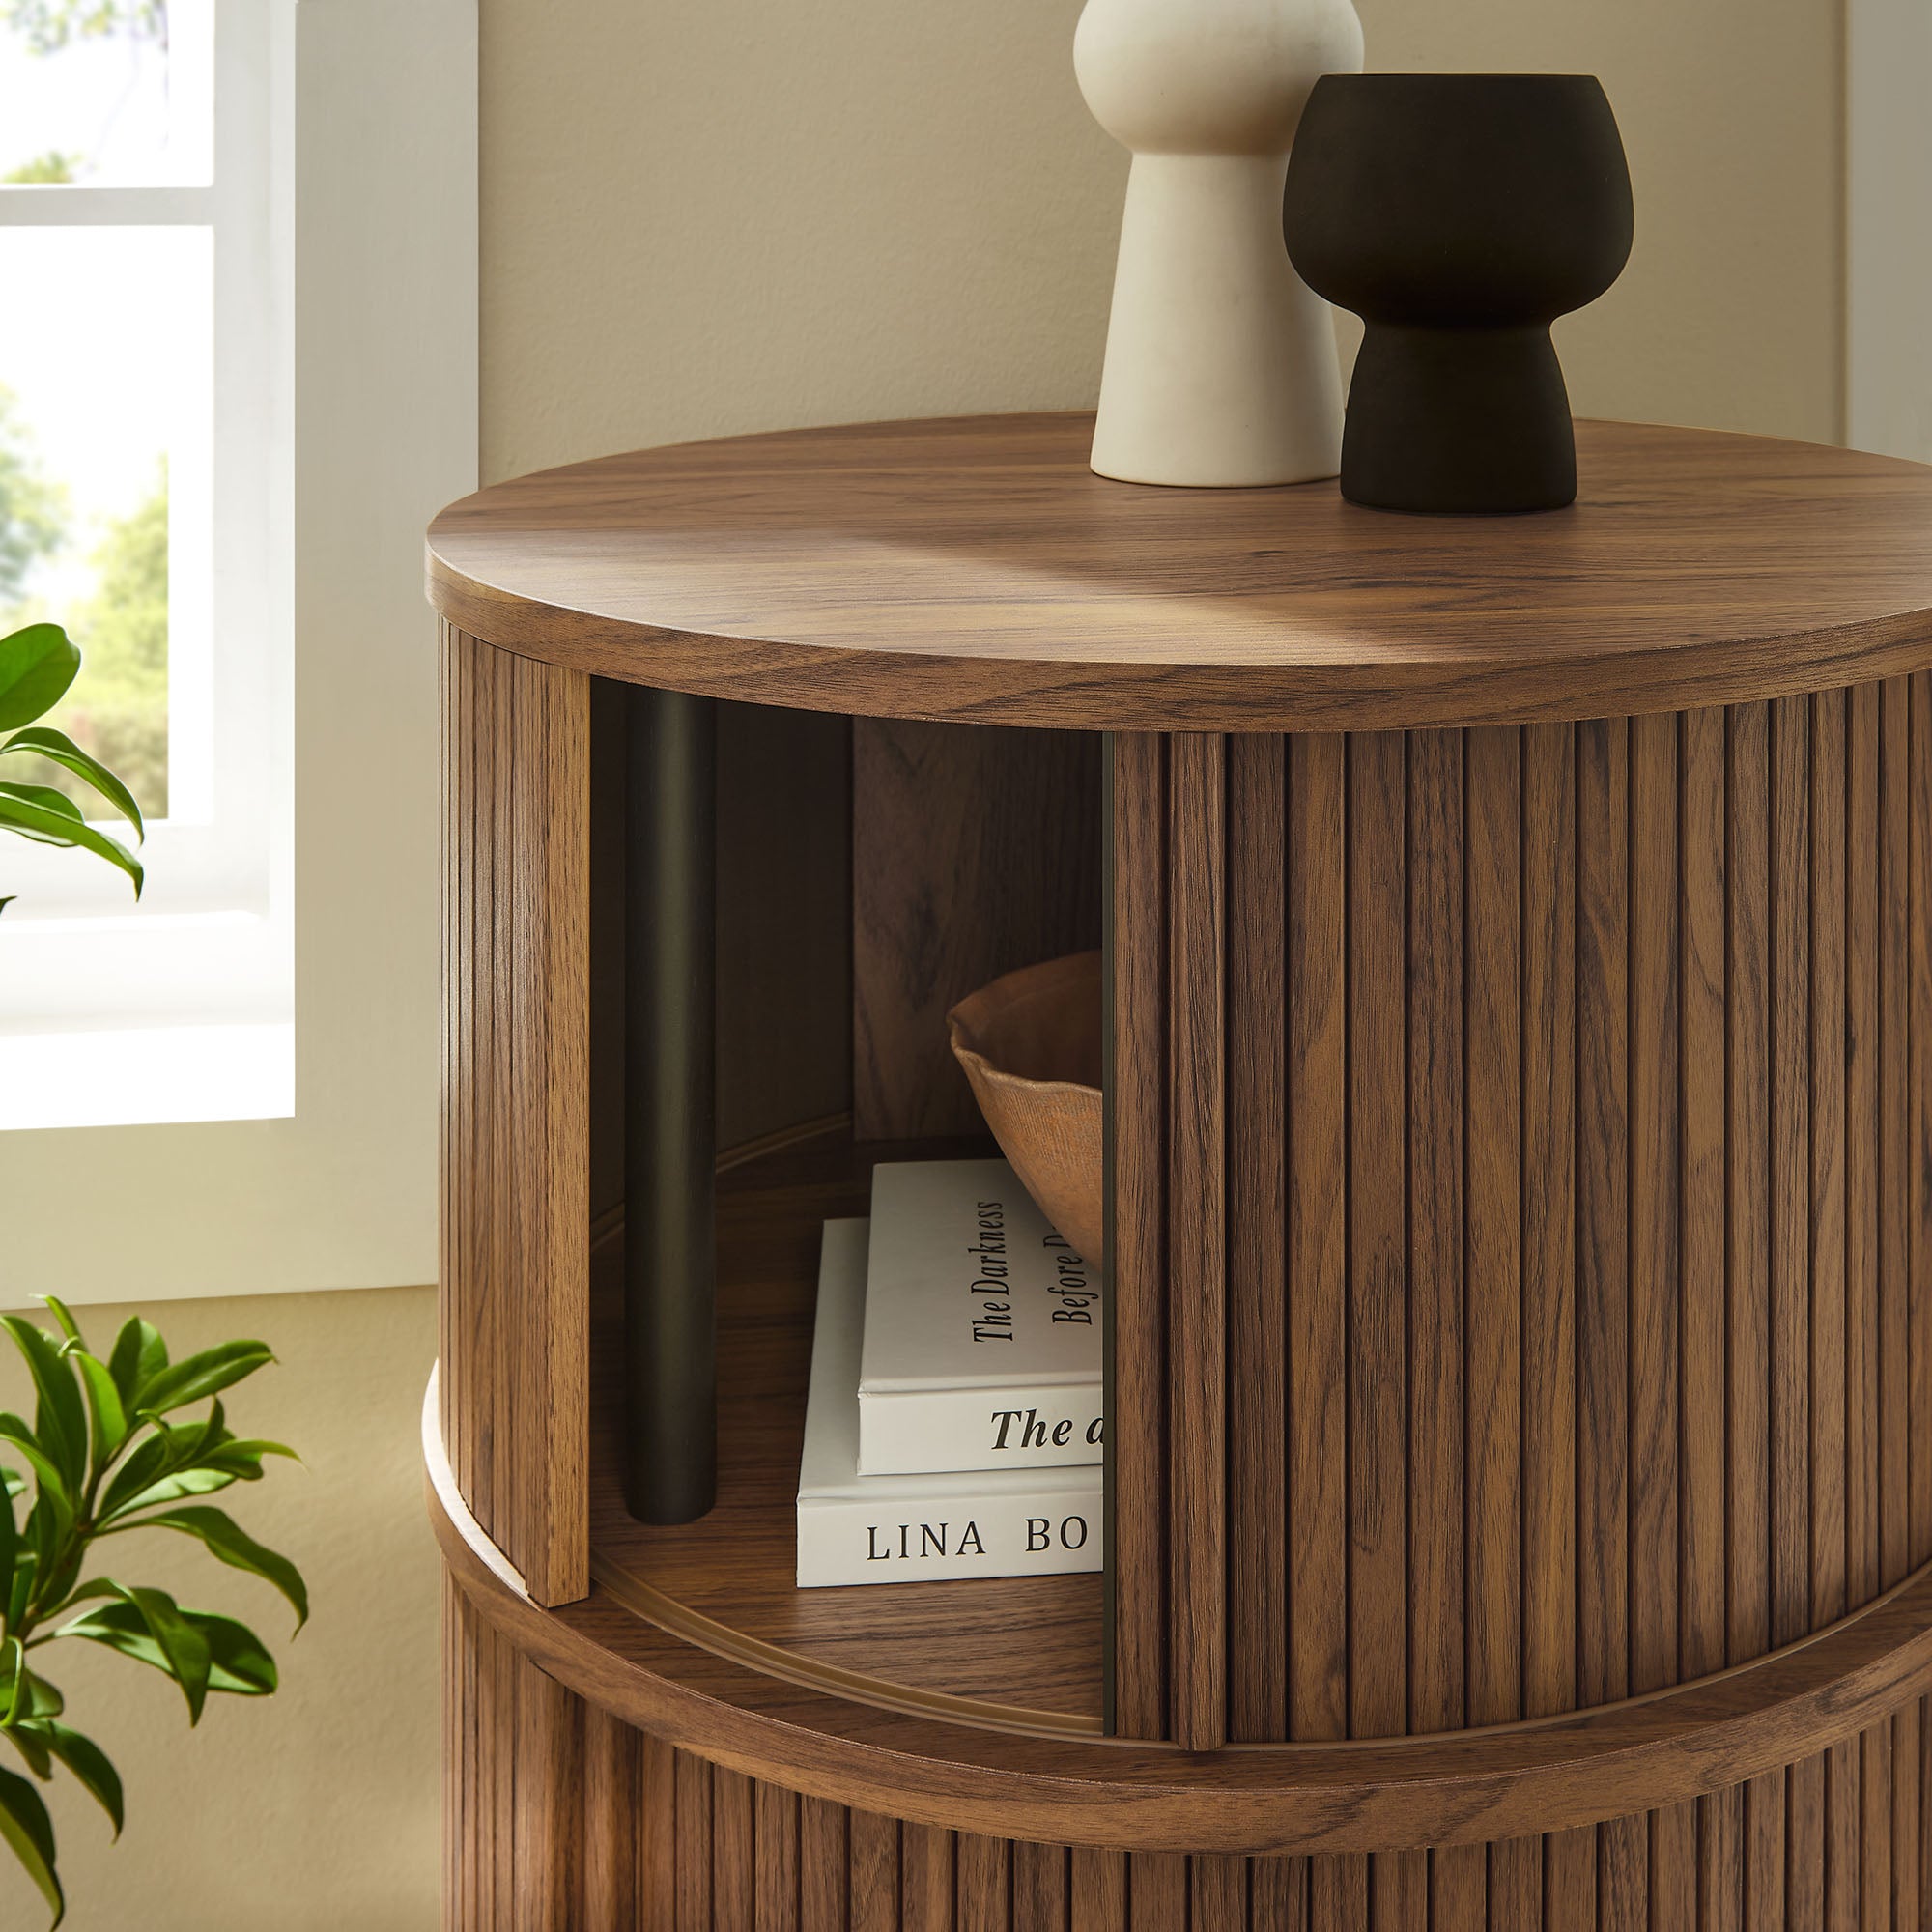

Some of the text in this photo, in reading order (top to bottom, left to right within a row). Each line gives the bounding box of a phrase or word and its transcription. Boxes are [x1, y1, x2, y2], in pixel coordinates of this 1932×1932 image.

[967, 1201, 1013, 1343] The Darkness
[1046, 1255, 1099, 1326] Before
[990, 1407, 1074, 1450] The
[867, 1515, 1089, 1561] LINA BO
